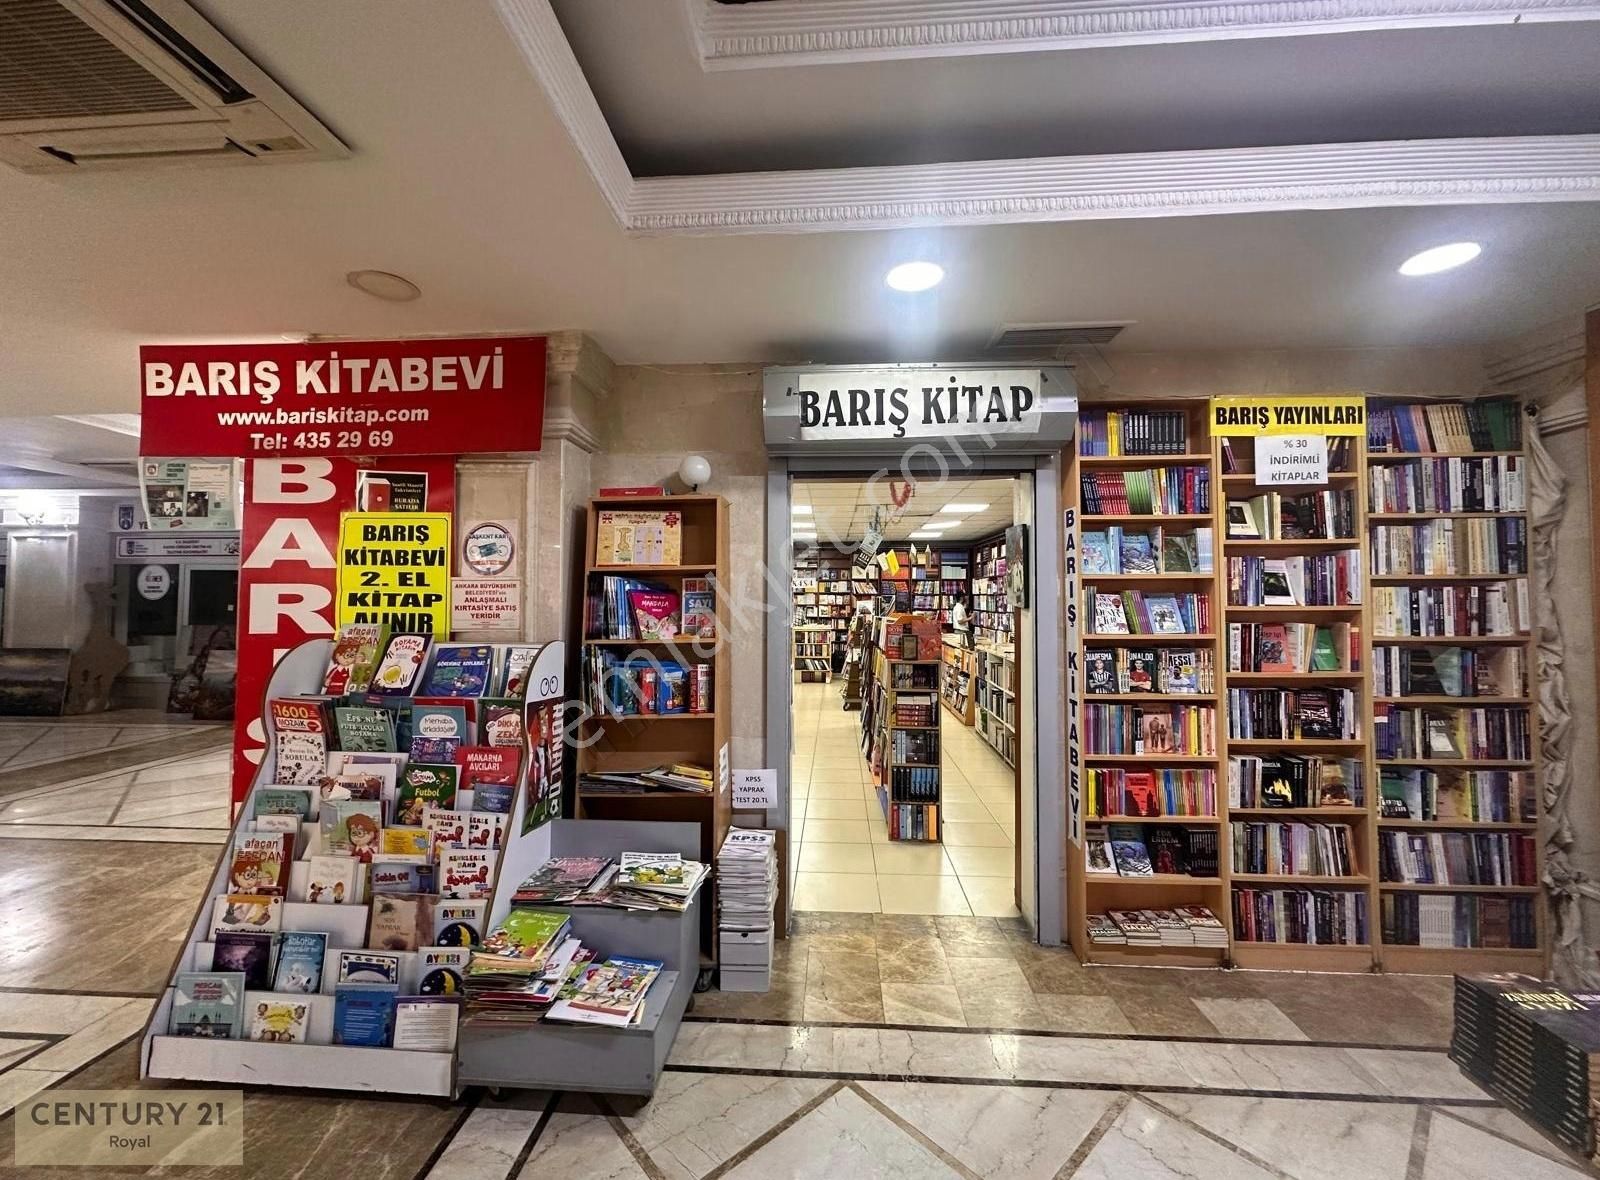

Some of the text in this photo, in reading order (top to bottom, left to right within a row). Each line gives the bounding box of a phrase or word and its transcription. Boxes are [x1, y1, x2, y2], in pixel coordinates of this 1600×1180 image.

[145, 346, 504, 404] BARIŞ KİTABEVİ
[799, 375, 1034, 438] BARIŞ KİTAP
[217, 406, 429, 427] www.bariskitap.com
[1215, 405, 1363, 428] BARIŞ YAYINLARI
[250, 430, 394, 451] Tel: 435 29 69
[1283, 438, 1308, 448] % 30
[1269, 453, 1320, 465] İNDİRİMLİ
[1270, 469, 1320, 482] KİTAPLAR
[362, 524, 430, 547] BARIŞ
[344, 547, 446, 568] KİTABEVİ
[360, 571, 431, 588] 2. EL
[347, 589, 443, 608] KİTAP
[464, 597, 507, 605] ANLAŞMALI
[495, 604, 517, 612] SATIŞ
[1065, 510, 1080, 840] BARIŞ KİTABEVİ
[275, 705, 309, 719] 1600
[466, 753, 503, 763] MAKARNA
[469, 762, 500, 771] AVCILARI
[414, 787, 440, 797] Futbol
[739, 786, 765, 794] YAPRAK
[735, 796, 750, 804] TEST
[244, 838, 279, 850] afacan
[730, 833, 766, 843] KPSS
